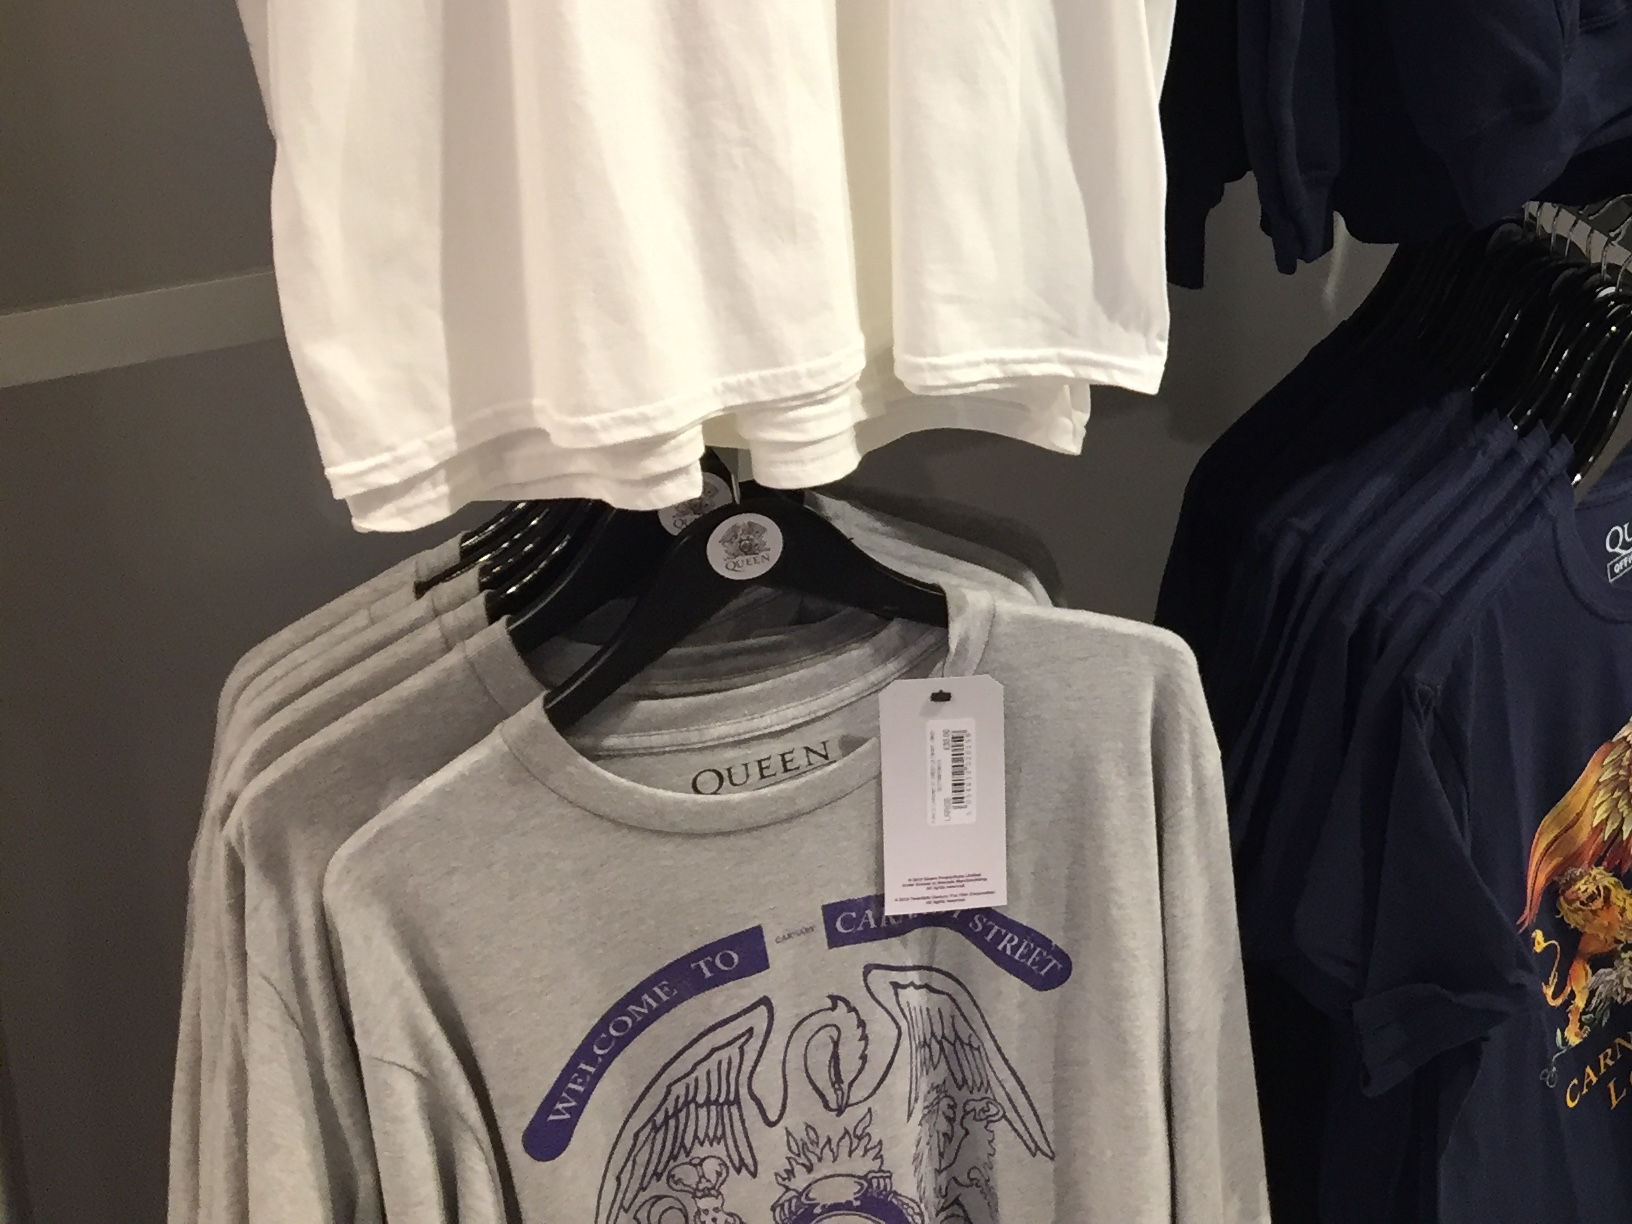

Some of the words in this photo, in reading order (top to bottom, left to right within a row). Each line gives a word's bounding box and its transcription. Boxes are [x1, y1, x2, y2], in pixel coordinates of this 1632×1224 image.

[724, 552, 771, 573] QUEEN
[691, 739, 830, 796] QUEEN
[968, 912, 1064, 977] STREET
[546, 979, 679, 1122] WELCOME
[690, 948, 740, 979] TO
